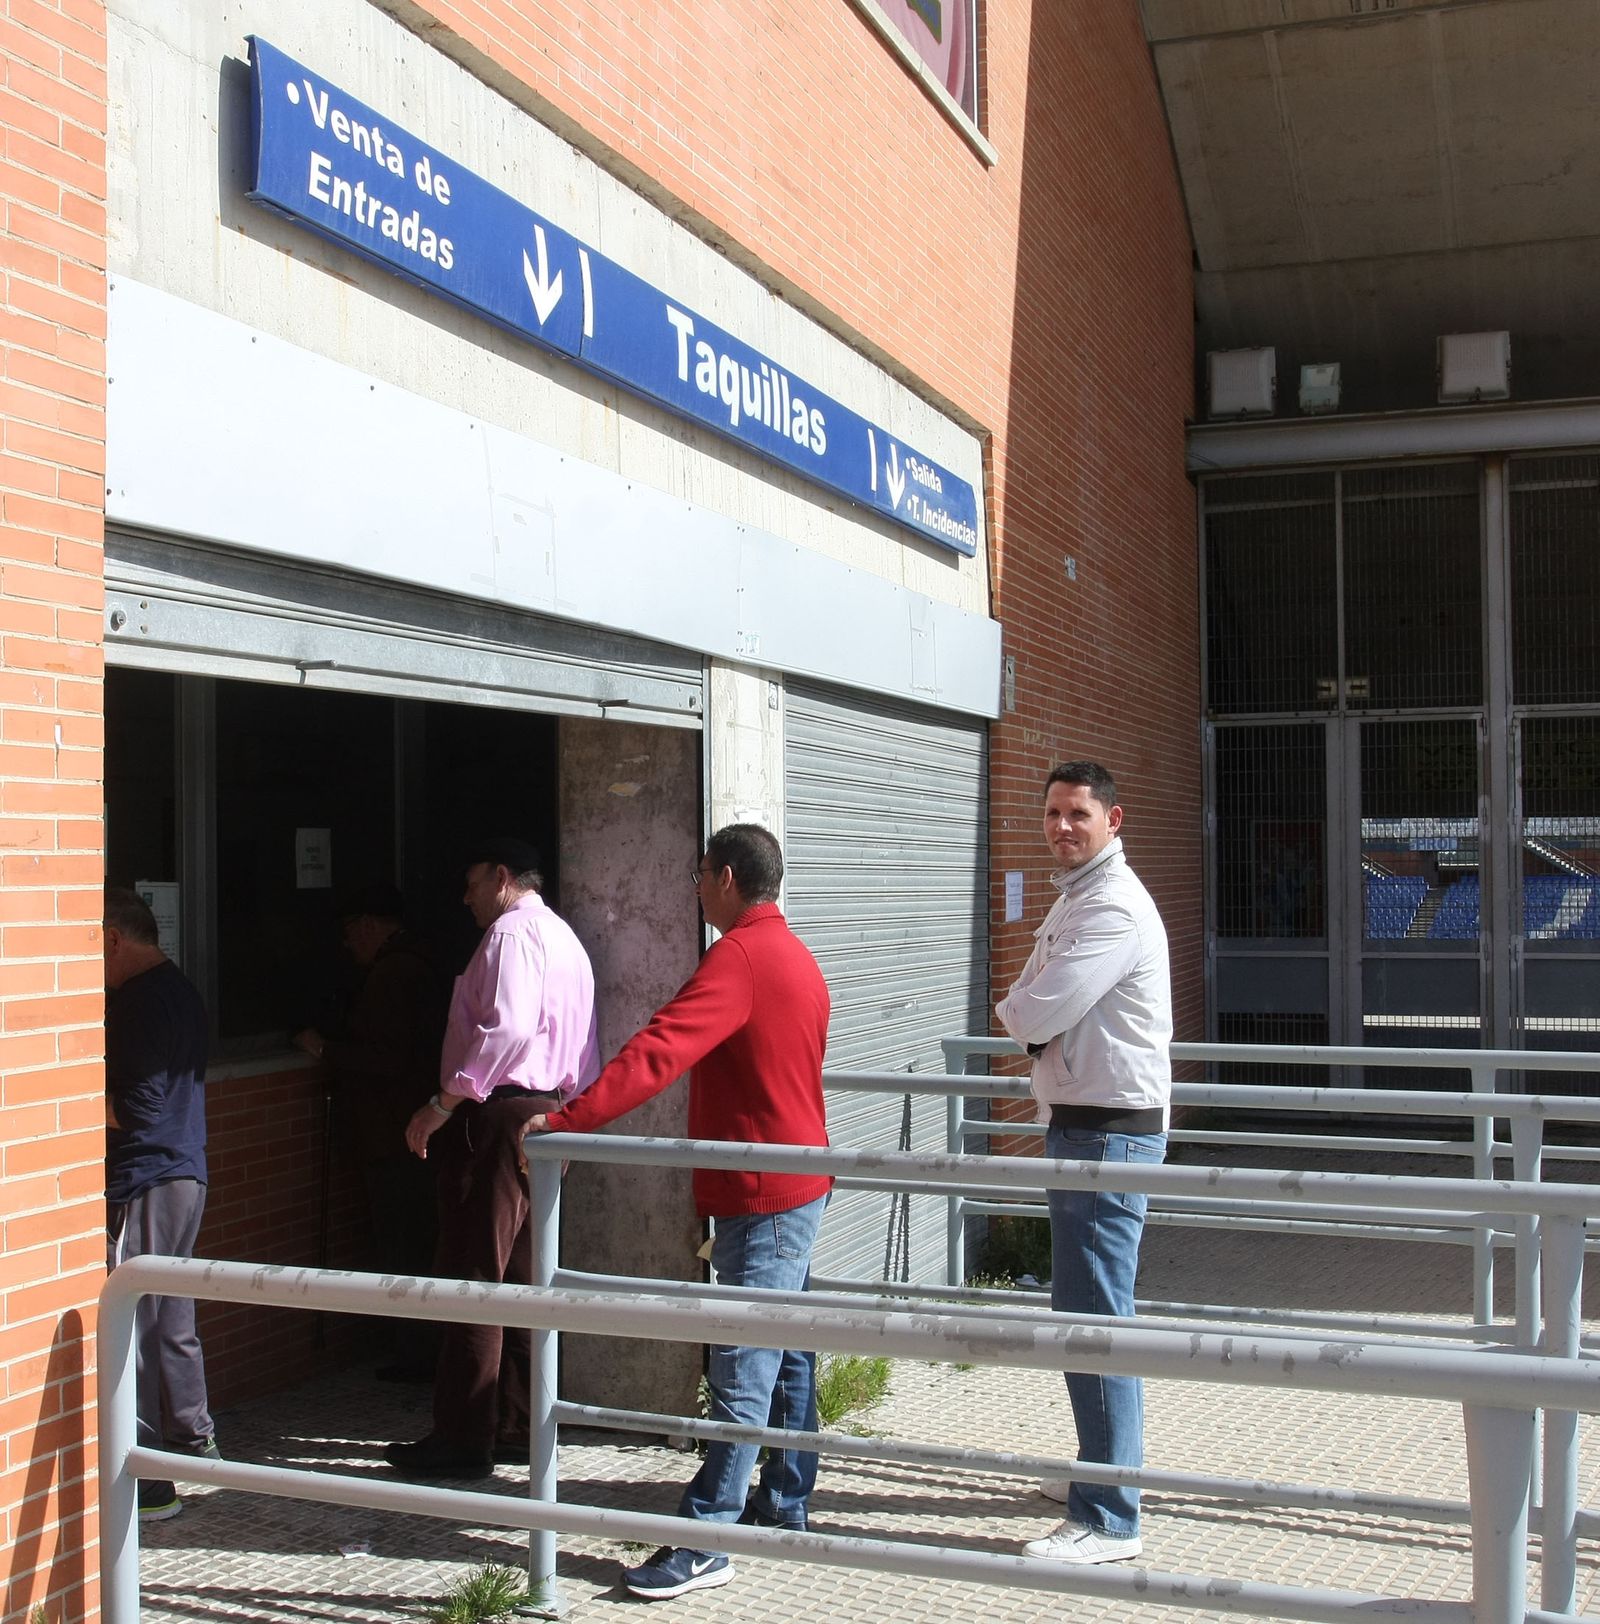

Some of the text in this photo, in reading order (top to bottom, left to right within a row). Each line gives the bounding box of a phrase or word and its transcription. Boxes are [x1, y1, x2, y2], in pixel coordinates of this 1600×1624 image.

[303, 79, 451, 205] Venta de
[308, 150, 454, 270] Entradas
[666, 303, 827, 456] Taquillas
[910, 456, 943, 494] Salida
[911, 494, 976, 547] T. Incidencias
